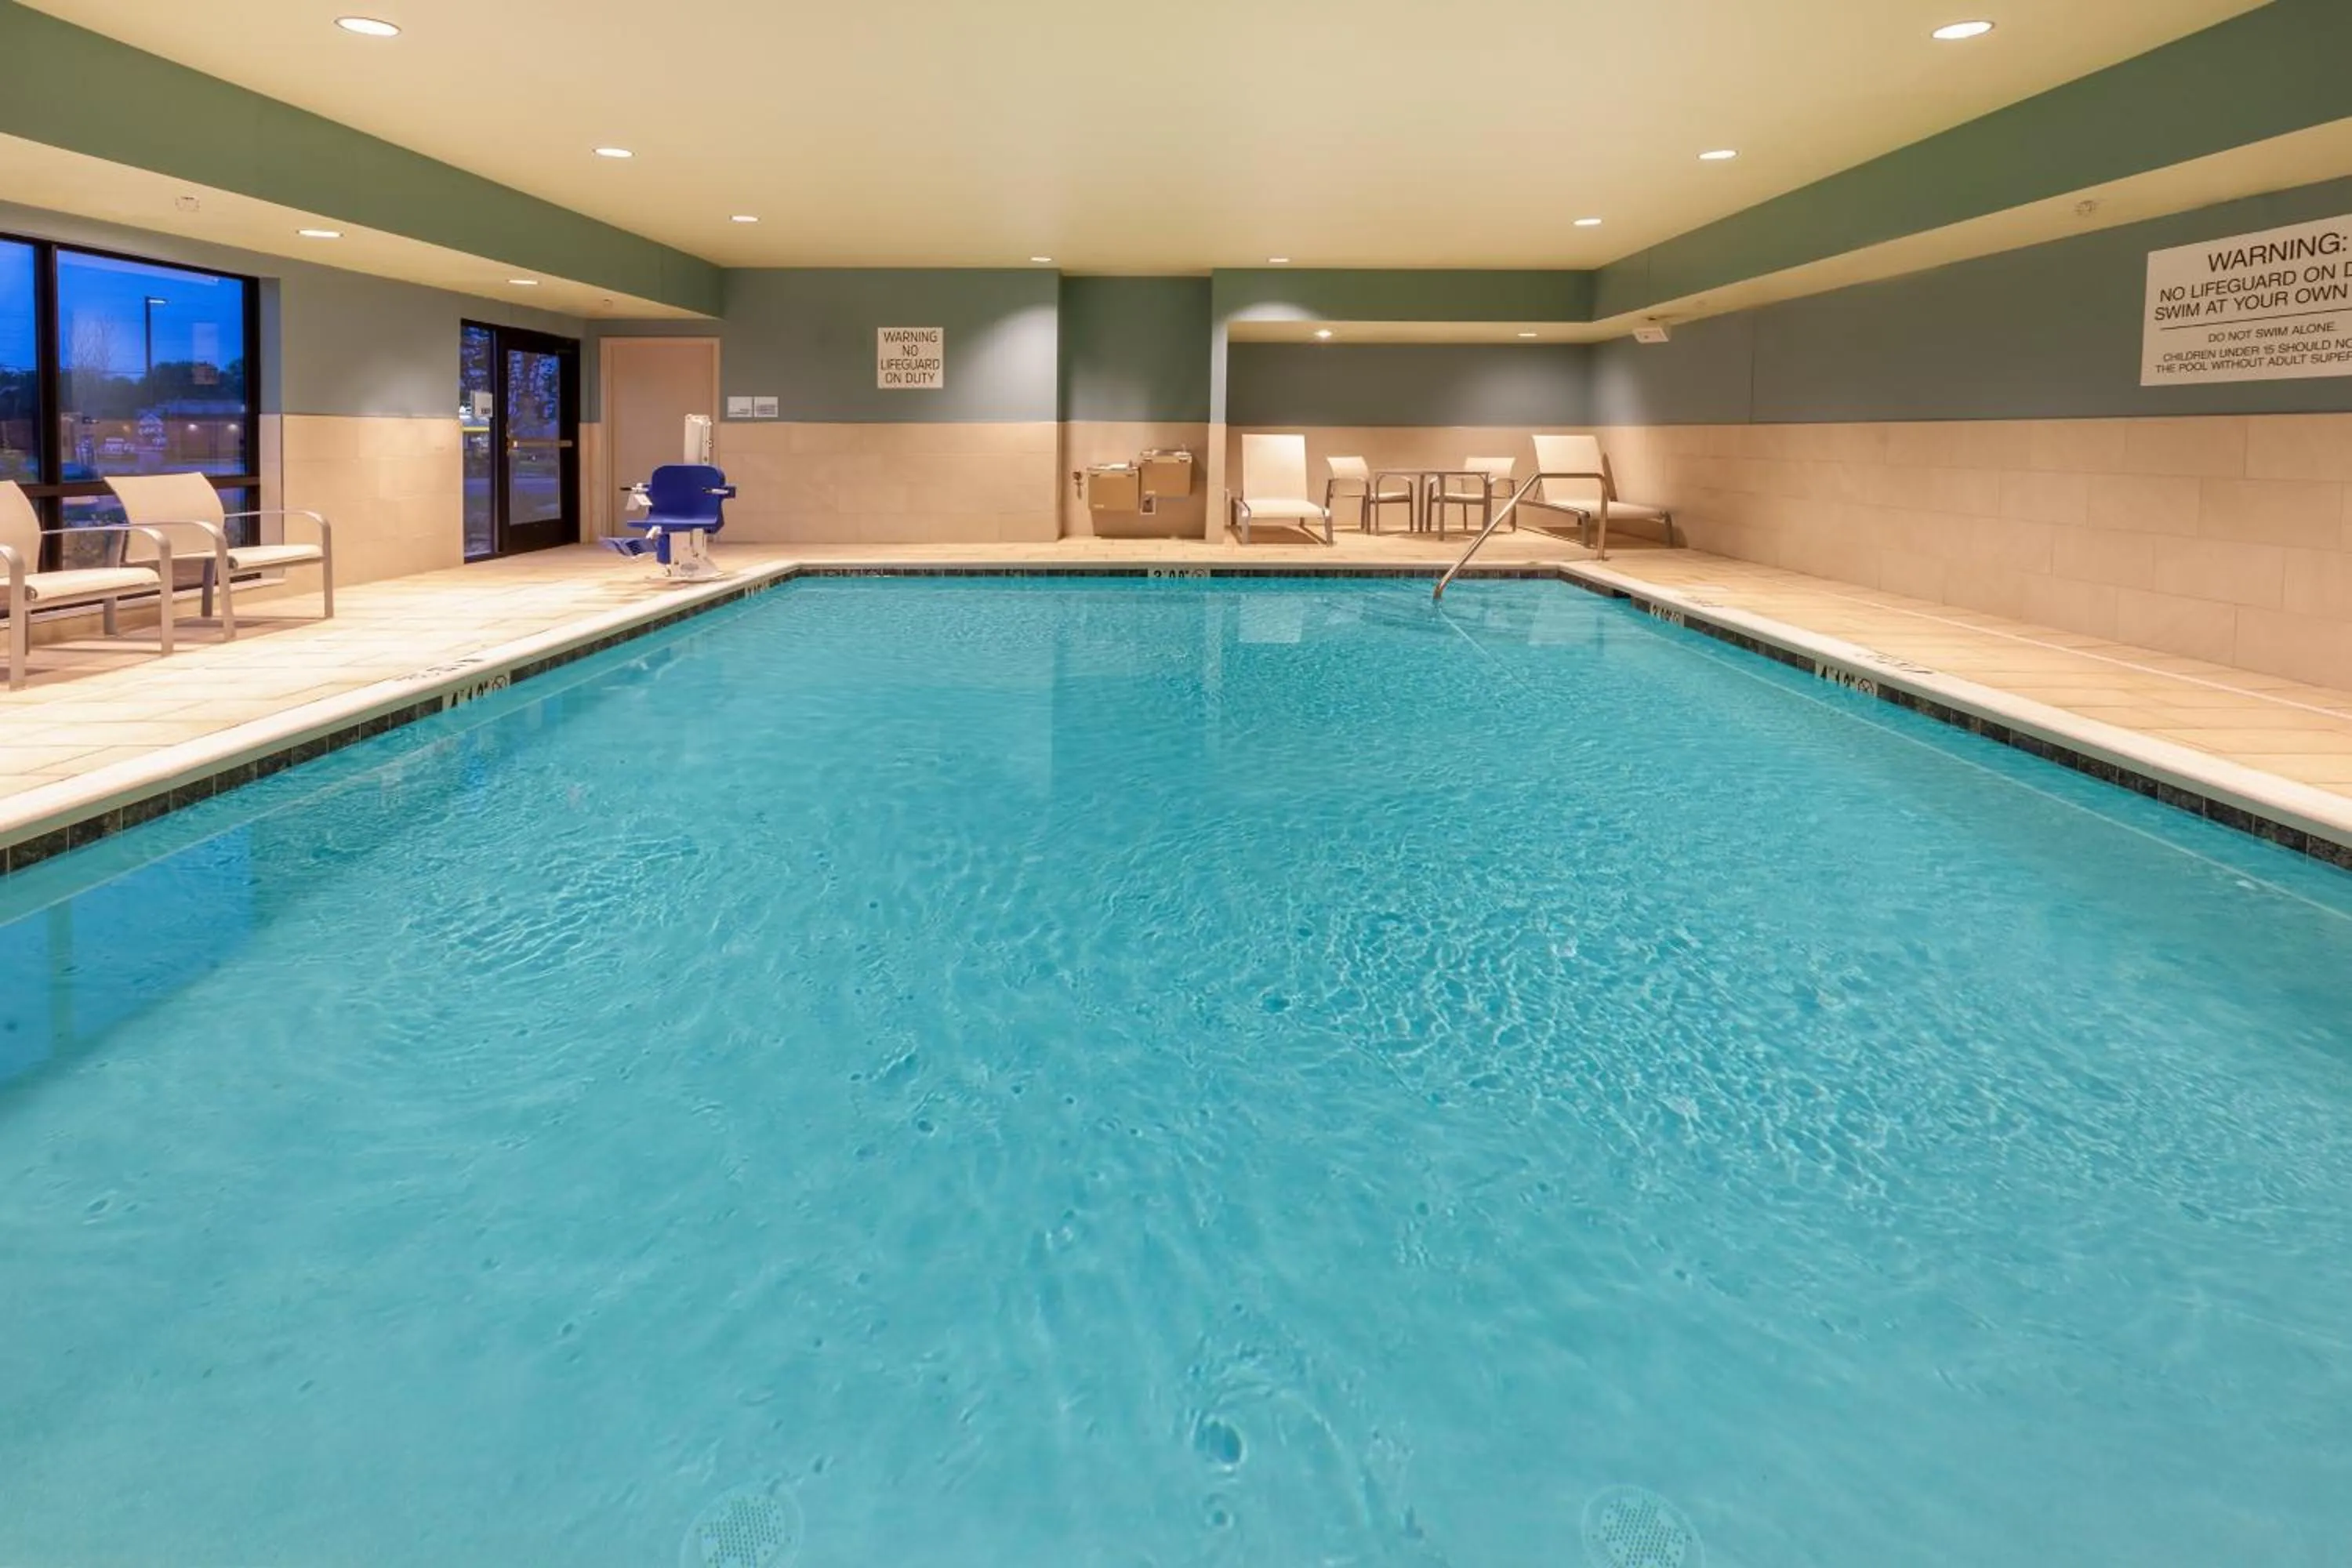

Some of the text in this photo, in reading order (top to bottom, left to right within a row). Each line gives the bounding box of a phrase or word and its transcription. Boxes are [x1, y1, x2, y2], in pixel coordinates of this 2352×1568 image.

[2208, 232, 2347, 273] WARNING:
[2160, 286, 2185, 302] NO
[2191, 270, 2296, 299] LIFEGUARD
[2303, 263, 2336, 282] ON
[2154, 283, 2348, 321] SWIM AT YOUR OWN
[884, 331, 938, 343] WARNING
[2208, 332, 2226, 343] DO
[2227, 329, 2252, 341] NOT
[2256, 326, 2289, 338] SWIM
[902, 344, 919, 357] NO
[2163, 350, 2216, 362] CHILDREN
[2219, 345, 2259, 358] UNDER
[2278, 339, 2332, 353] SHOULD
[880, 358, 940, 371] LIFEGUARD
[2156, 363, 2176, 373] THE
[2179, 361, 2208, 372] POOL
[2211, 356, 2265, 370] WITHOUT
[2267, 354, 2307, 367] ADULT
[885, 372, 935, 383] ON DUTY
